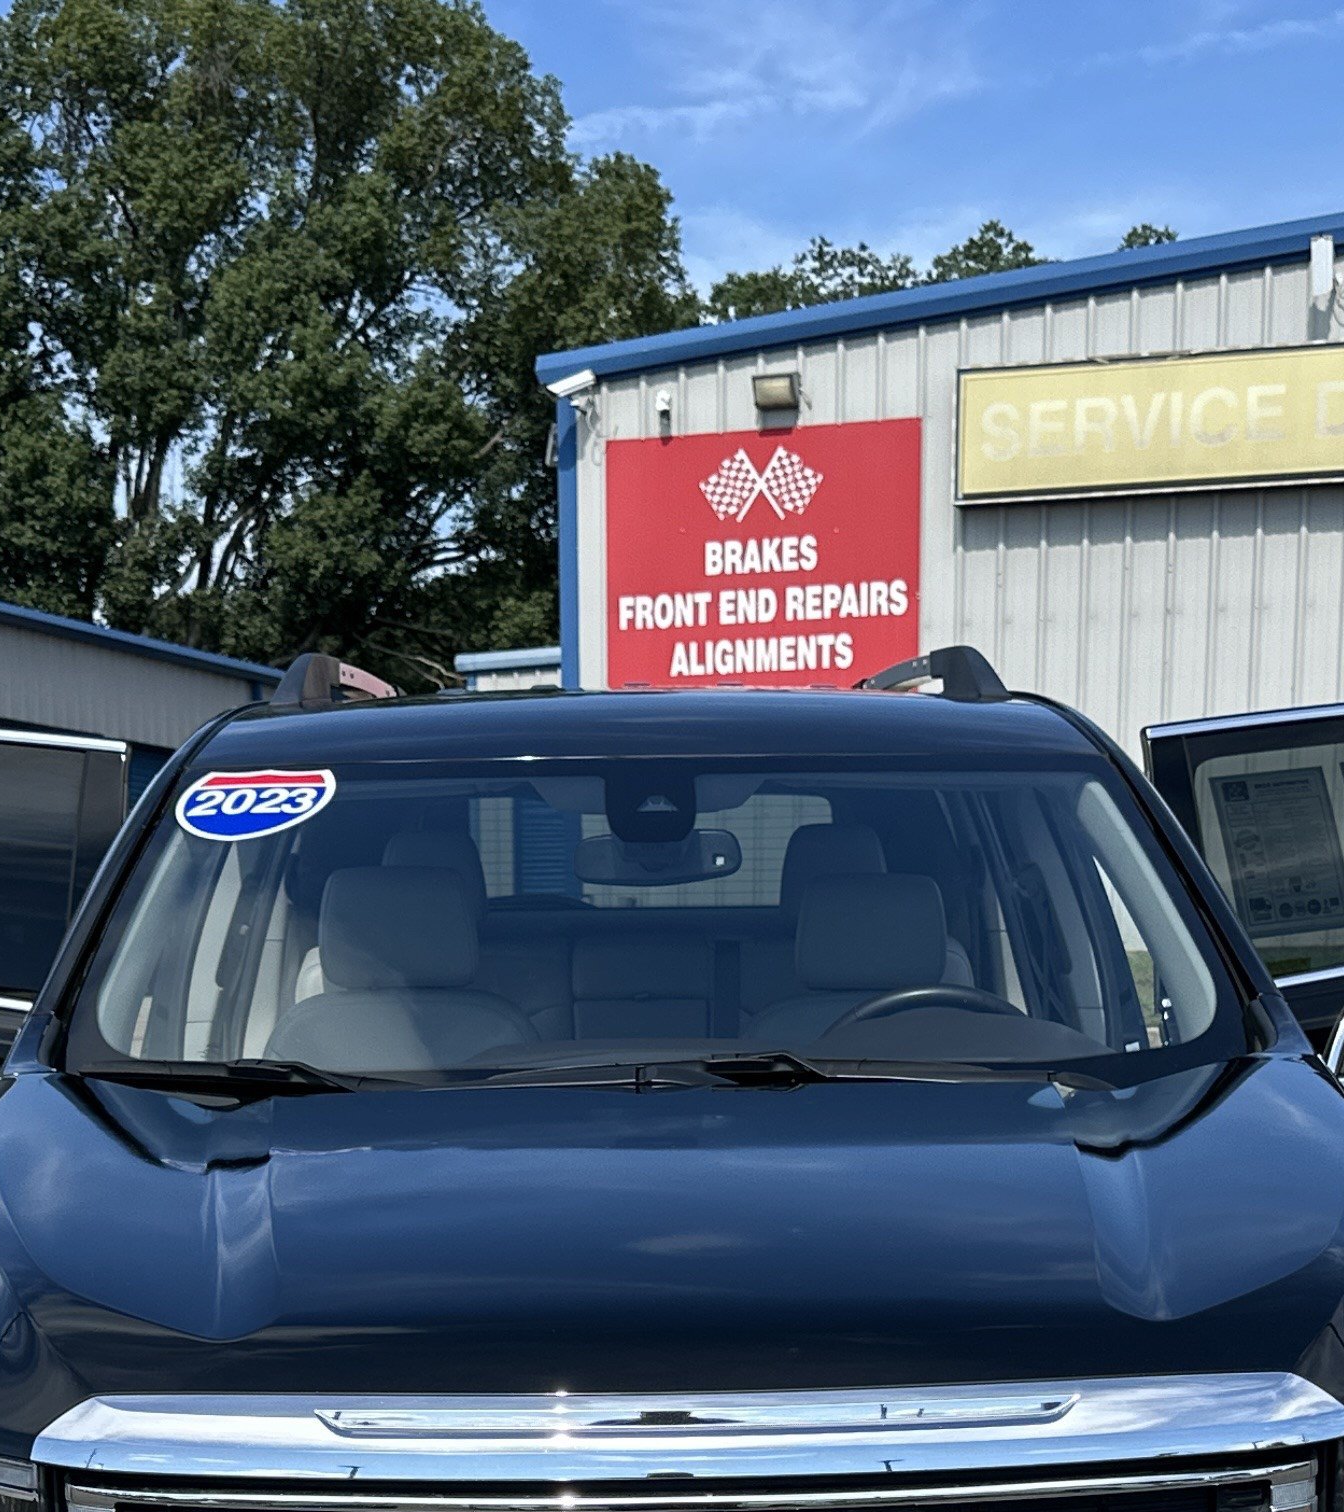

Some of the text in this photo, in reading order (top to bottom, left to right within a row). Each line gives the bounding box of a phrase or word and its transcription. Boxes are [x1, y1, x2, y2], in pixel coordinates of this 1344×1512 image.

[981, 382, 1287, 462] SERVICE
[705, 535, 818, 576] BRAKES
[619, 580, 909, 630] FRONT END REPAIRS
[669, 633, 854, 677] ALIGNMENTS
[186, 788, 318, 817] 2023
